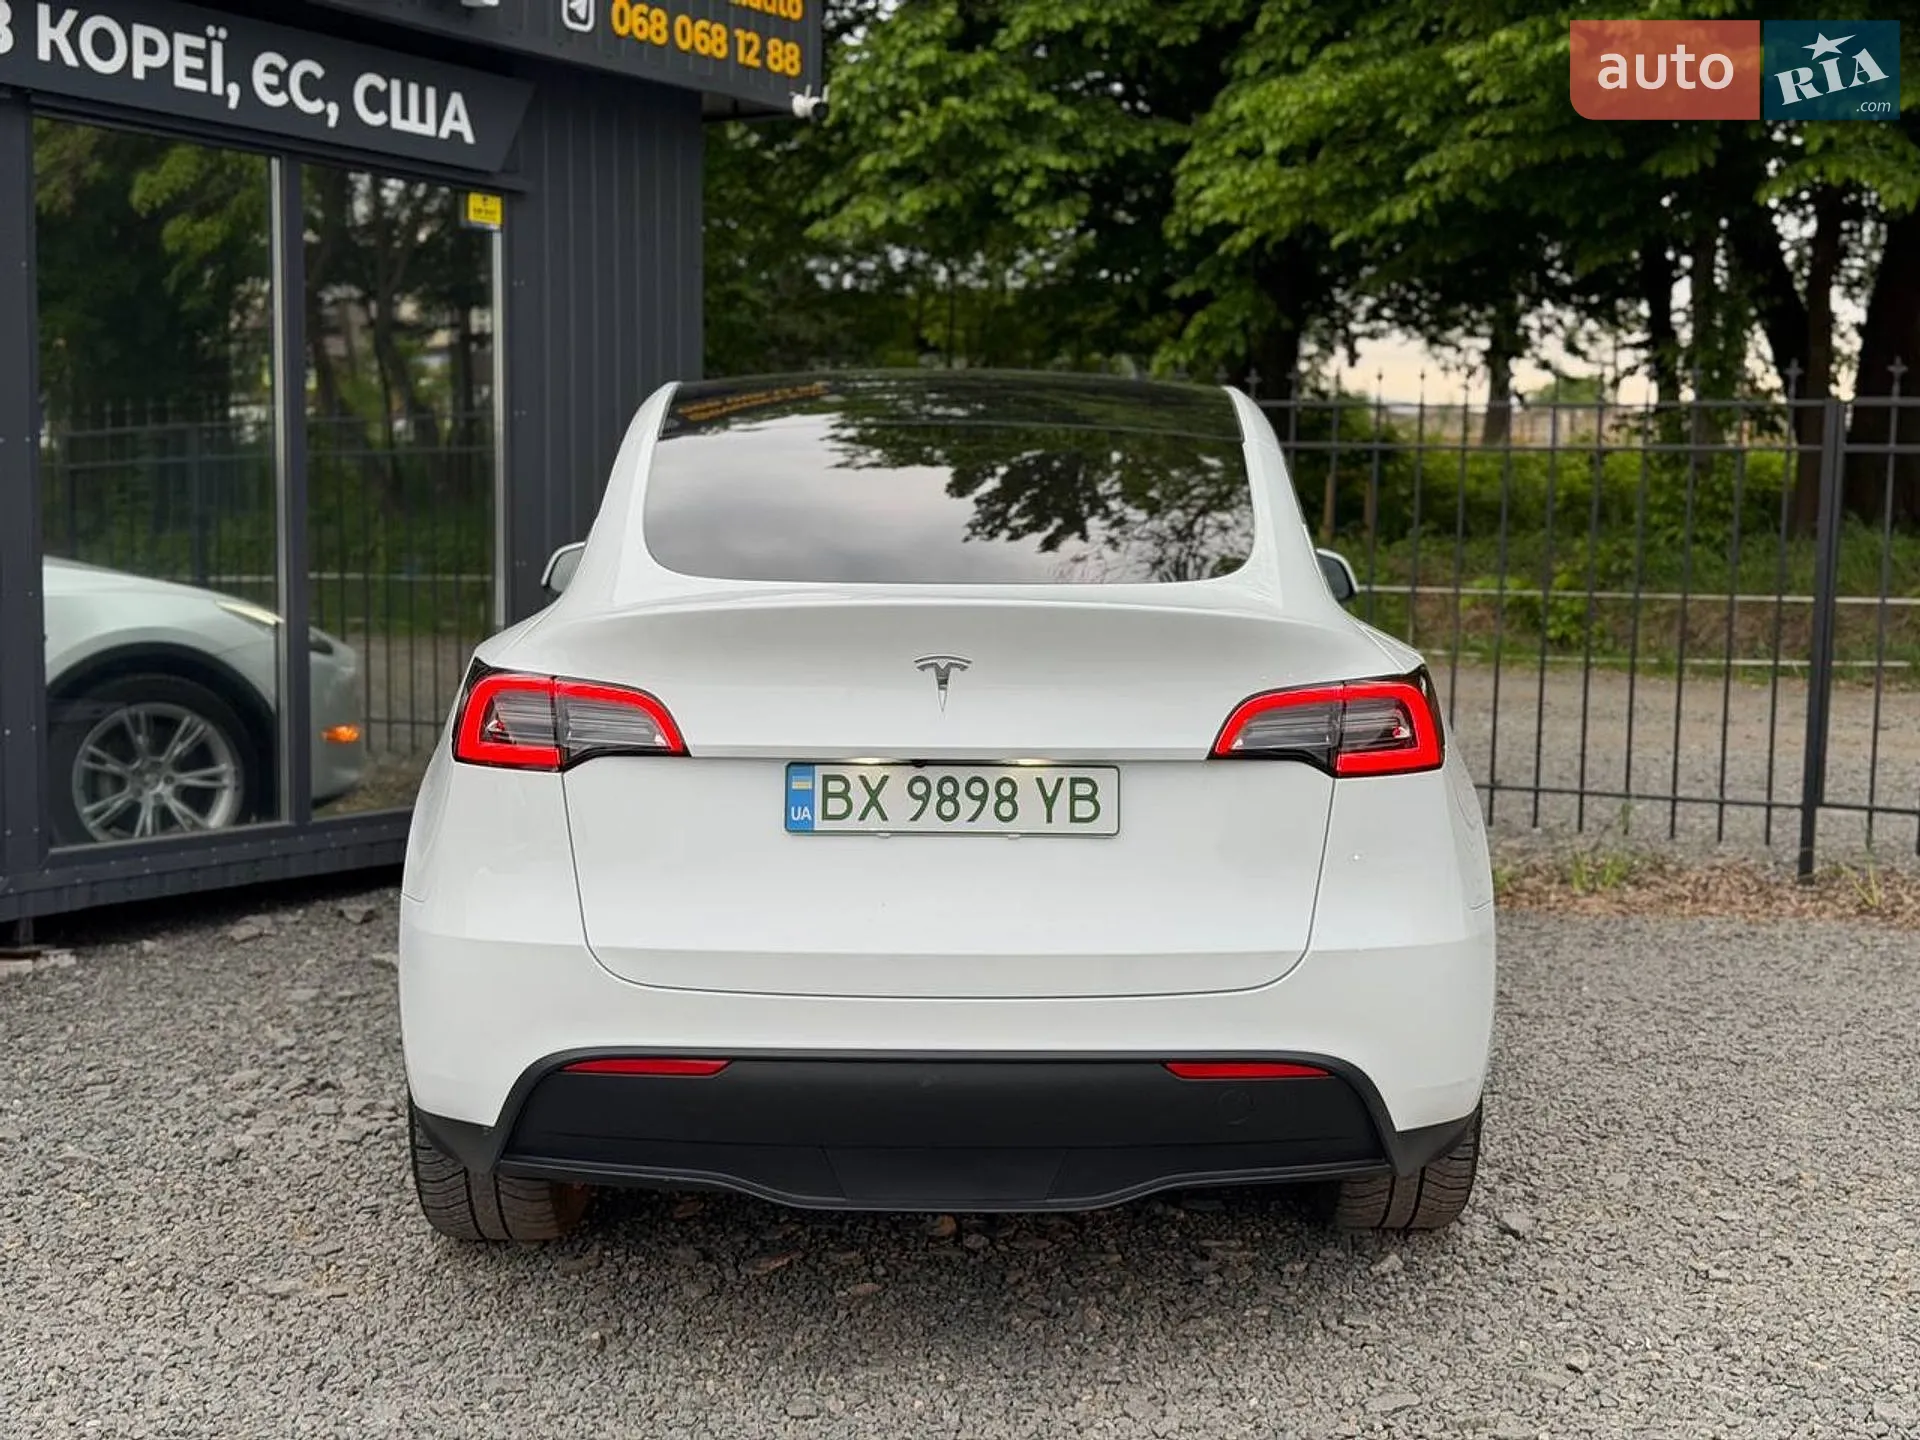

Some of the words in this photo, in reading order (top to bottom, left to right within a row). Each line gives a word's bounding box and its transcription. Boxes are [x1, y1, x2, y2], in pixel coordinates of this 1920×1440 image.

[611, 0, 669, 45] 068
[674, 14, 728, 59] 068
[734, 28, 762, 68] 12
[766, 37, 802, 77] 88
[37, 2, 241, 110] КОРЕЇ,
[252, 51, 340, 128] ЄС,
[353, 72, 476, 145] США
[791, 806, 812, 821] UA
[821, 774, 891, 822] BX
[907, 775, 1019, 823] 9898
[1035, 776, 1101, 824] YB
